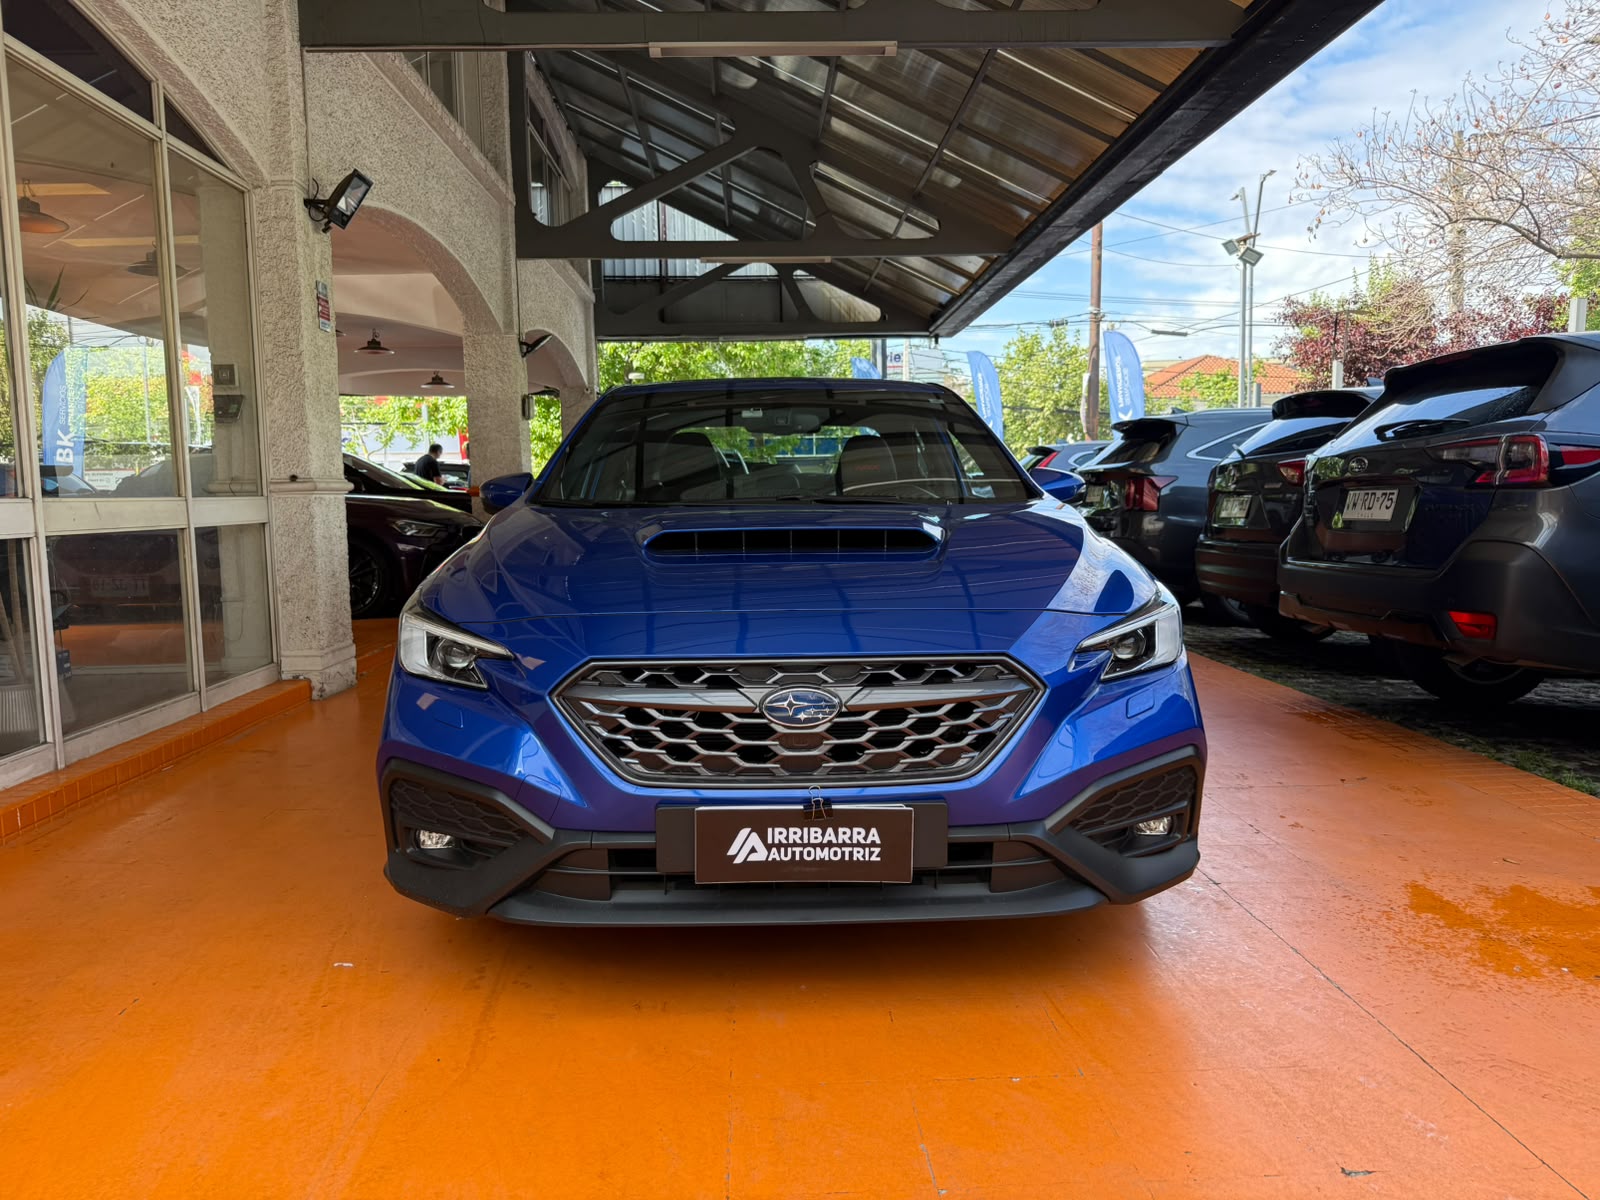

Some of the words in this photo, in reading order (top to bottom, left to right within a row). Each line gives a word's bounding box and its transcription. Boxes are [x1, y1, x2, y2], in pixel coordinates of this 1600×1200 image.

[55, 429, 75, 464] BK
[767, 827, 881, 844] IRRIBARRA
[767, 847, 881, 861] AUTOMOTRIZ
